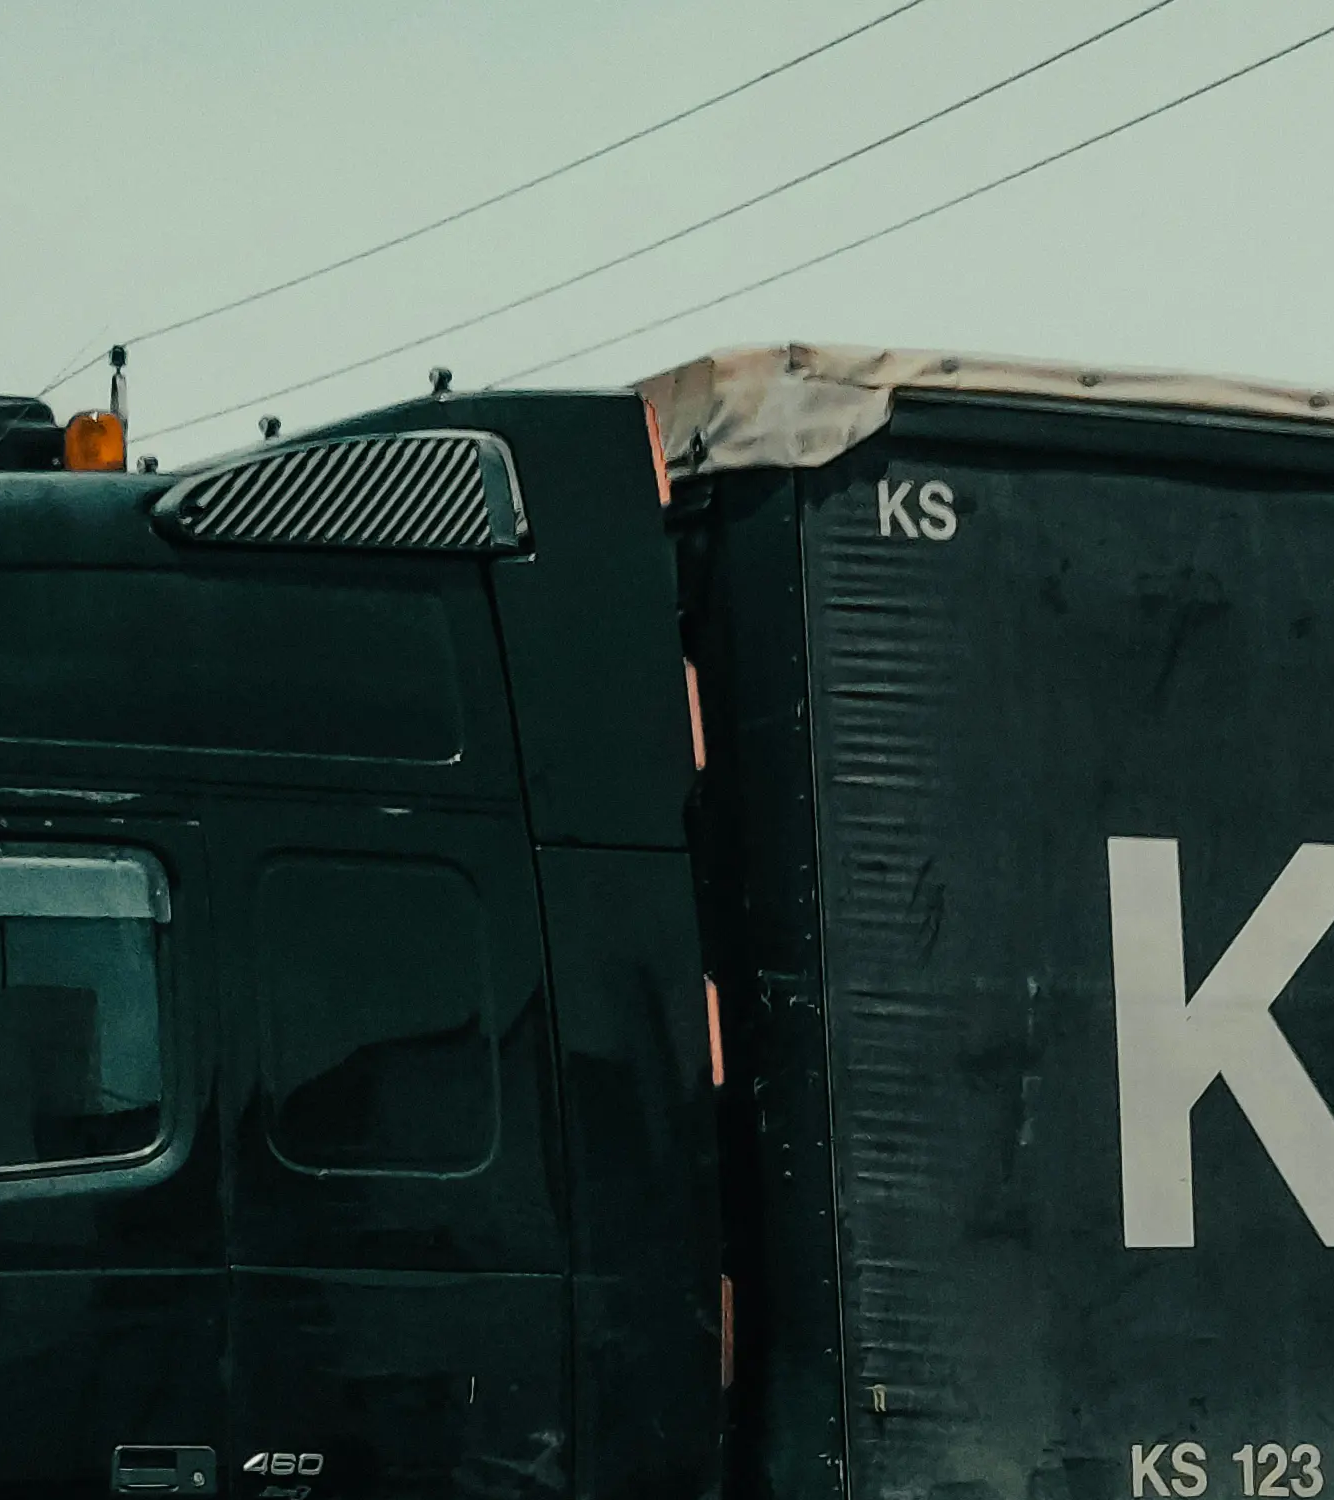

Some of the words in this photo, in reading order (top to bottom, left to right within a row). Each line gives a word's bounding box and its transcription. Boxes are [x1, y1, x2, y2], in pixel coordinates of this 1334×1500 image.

[877, 479, 958, 541] KS
[243, 1452, 324, 1476] 460
[1131, 1441, 1208, 1498] KS
[1232, 1443, 1325, 1499] 123
